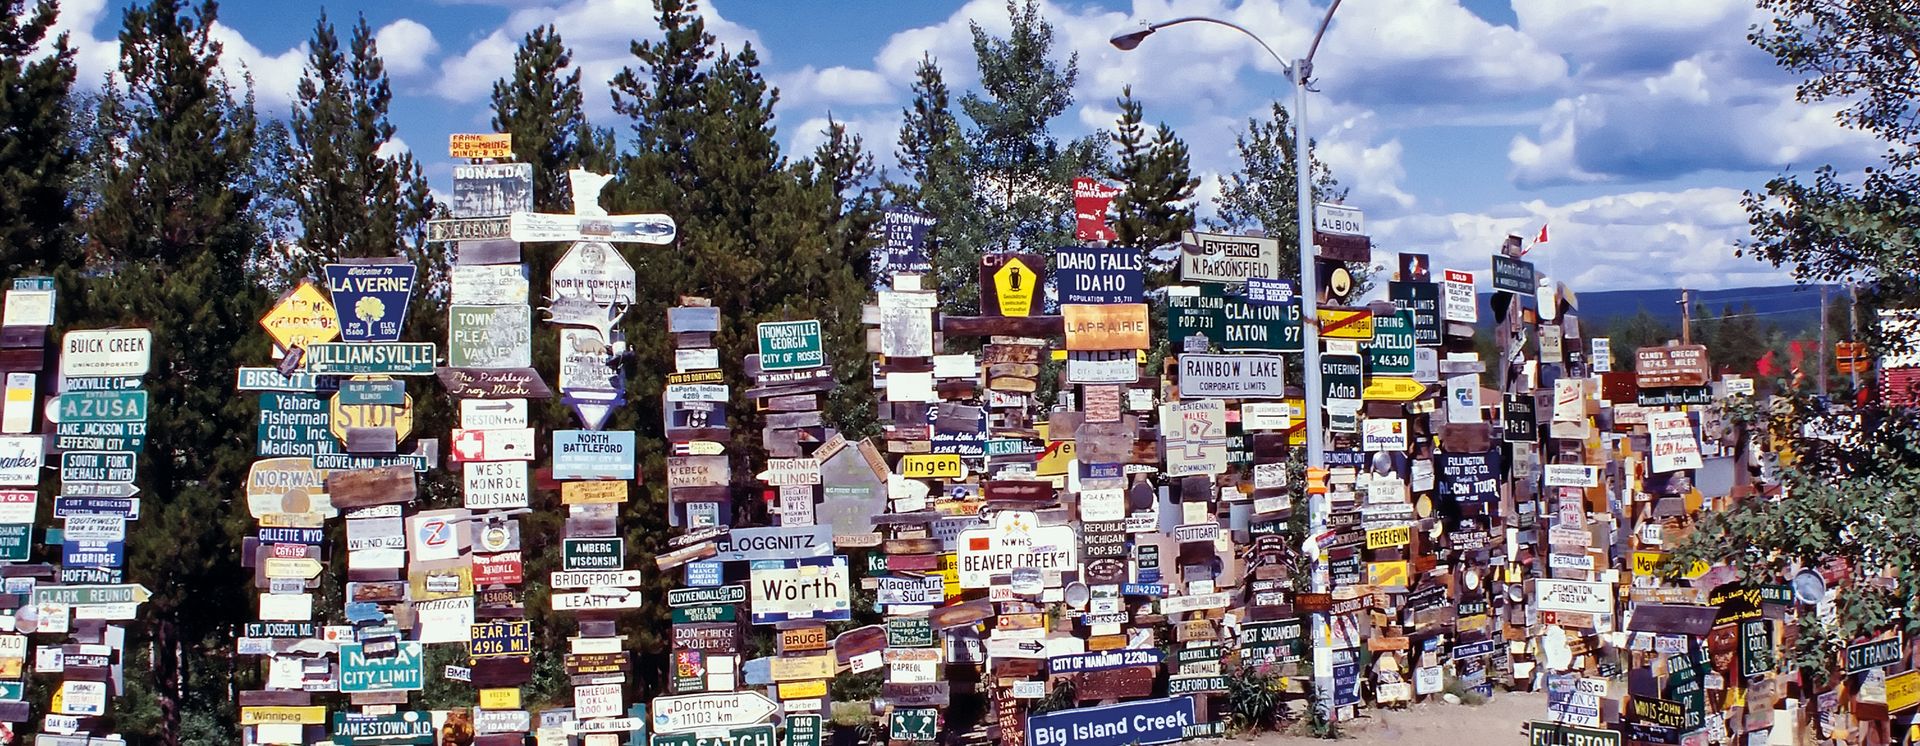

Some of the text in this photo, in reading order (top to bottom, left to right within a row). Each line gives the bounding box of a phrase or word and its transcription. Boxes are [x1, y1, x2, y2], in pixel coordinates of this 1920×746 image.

[456, 167, 524, 179] DONALDA
[1077, 182, 1100, 191] DALE
[1321, 218, 1359, 231] ALBION
[1205, 243, 1258, 257] ENTERING
[1057, 252, 1142, 271] IDAHO FALLS
[348, 268, 381, 276] Welcome
[1452, 273, 1467, 281] SOLD
[332, 277, 409, 292] LA VERNE
[555, 280, 584, 288] NORTH
[1076, 275, 1125, 290] IDAHO
[1170, 297, 1223, 308] PUGET ISLAND
[1414, 299, 1434, 310] LIMITS
[1225, 305, 1299, 320] CLAYTON 15
[1068, 322, 1144, 333] LAPRAIRIE
[1199, 316, 1213, 328] 731
[760, 325, 816, 339] THOMASVILLE
[1226, 326, 1300, 342] RATON 97
[70, 338, 144, 353] BUICK CREEK
[771, 337, 808, 350] GEORGIA
[307, 346, 431, 364] WILLIAMSVILLE
[762, 351, 821, 364] CITY OF ROSES
[1076, 351, 1130, 361] TYLER
[1187, 362, 1277, 377] RAINBOW LAKE
[1322, 364, 1360, 375] ENTERING
[691, 372, 721, 382] DORTMUND
[68, 378, 110, 389] ROCKVILLE
[1199, 381, 1266, 391] CORPORATE LIMITS
[671, 386, 699, 394] LaPorte,
[1329, 383, 1355, 398] Adna
[65, 398, 139, 417] AZUSA
[276, 395, 320, 410] Yahara
[1172, 402, 1218, 412] BICENTENNIAL
[261, 411, 328, 424] Fisherman
[338, 405, 405, 427] STOP
[466, 416, 502, 425] RESTON
[1184, 412, 1208, 420] WALKER
[57, 423, 146, 436] LAKE JACKSON TEX
[268, 426, 296, 441] Club
[57, 436, 124, 450] JEFFERSON CITY
[577, 434, 609, 444] NORTH
[261, 439, 314, 455] Madison
[563, 443, 623, 453] BATTLEFORD
[958, 445, 982, 454] Miles
[989, 441, 1022, 453] NELSON
[70, 455, 127, 467] SOUTH FORK
[317, 456, 422, 470] GROVELAND FLORIDA
[770, 461, 818, 471] VIRGINIA
[904, 458, 957, 474] lingen
[1448, 457, 1485, 465] FULLINGTON
[63, 468, 132, 480] CHEHALIS RIVER
[1179, 464, 1216, 472] COMMUNITY
[1444, 466, 1476, 474] AUTO BUS
[470, 477, 521, 490] MONROE
[770, 472, 818, 484] ILLINOIS
[97, 486, 121, 494] RIVER
[1474, 479, 1497, 493] TOUR
[88, 500, 130, 508] HENDRICKSON
[465, 495, 526, 505] LOUISIANA
[69, 517, 121, 525] SOUTHWEST
[1084, 523, 1126, 532] REPUBLIC
[1176, 526, 1218, 541] STUTTGART
[259, 529, 323, 542] GILLETTE WYO
[1084, 535, 1125, 544] MICHIGAN
[1370, 528, 1408, 545] FREE KEVIN
[386, 537, 403, 547] 422
[717, 534, 815, 553] GLOGGNITZ
[1001, 538, 1032, 546] NWHS
[576, 544, 612, 553] AMBERG
[69, 553, 116, 564] UXBRIDGE
[570, 556, 617, 566] WISCONSIN
[965, 554, 1011, 571] BEAVER
[1553, 556, 1591, 566] PETALUMA
[62, 568, 109, 583] HOFFMAN
[555, 574, 623, 586] BRIDGEPORT
[763, 578, 837, 601] Wörth
[1553, 585, 1592, 594] EDMONTON
[40, 591, 79, 602] CLARK
[565, 595, 610, 607] LEAHY
[670, 590, 743, 603] KUYKENDALL RD
[902, 591, 925, 602] Süd
[685, 607, 723, 616] NORTH BEND
[691, 613, 716, 621] OREGON
[249, 625, 262, 636] ST.
[676, 629, 698, 638] DON
[1241, 624, 1300, 642] WEST SACRAMENTO
[683, 638, 731, 649] ROBERTS
[784, 635, 823, 645] BRUCE
[474, 640, 503, 653] 4916
[1864, 641, 1899, 664] FRANCIS
[892, 663, 921, 672] CAPREOL
[1053, 653, 1157, 671] CITY OF NANAIMO km
[1183, 663, 1216, 673] ESQUIMALT
[343, 670, 418, 684] CITY LIMIT
[578, 687, 620, 696] TAHLEQUAH
[1170, 681, 1208, 691] SEAFORD
[674, 698, 739, 712] Dortmund
[1658, 702, 1681, 715] JOHN
[253, 711, 301, 722] Winnipeg
[681, 711, 732, 724] 11103 km
[1658, 713, 1685, 726] GALT?
[335, 722, 407, 736] JAMESTOWN
[609, 721, 631, 729] HILLS
[1035, 710, 1188, 746] Big Island Creek
[1182, 725, 1212, 737] RAYTOWN
[659, 733, 768, 746] WASATCH
[1533, 728, 1615, 746] FULLERTON
